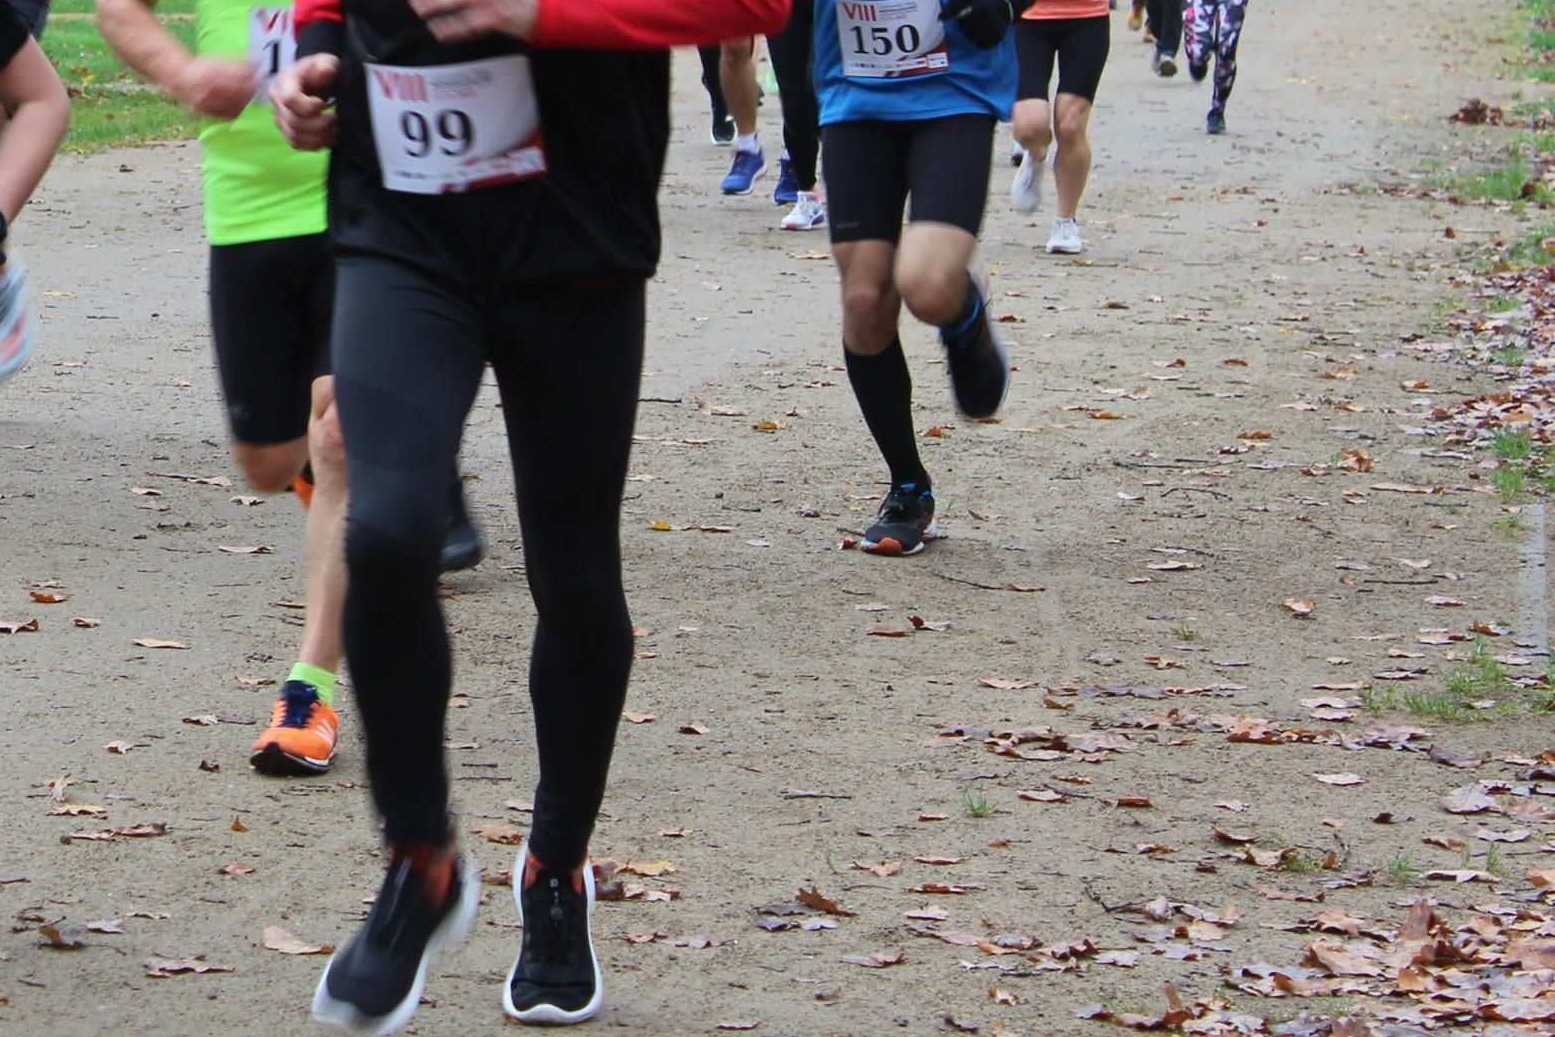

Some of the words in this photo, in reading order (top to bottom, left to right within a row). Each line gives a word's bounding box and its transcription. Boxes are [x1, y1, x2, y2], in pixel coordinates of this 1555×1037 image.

[841, 2, 877, 22] VIII
[850, 24, 920, 56] 150
[399, 108, 473, 158] 99
